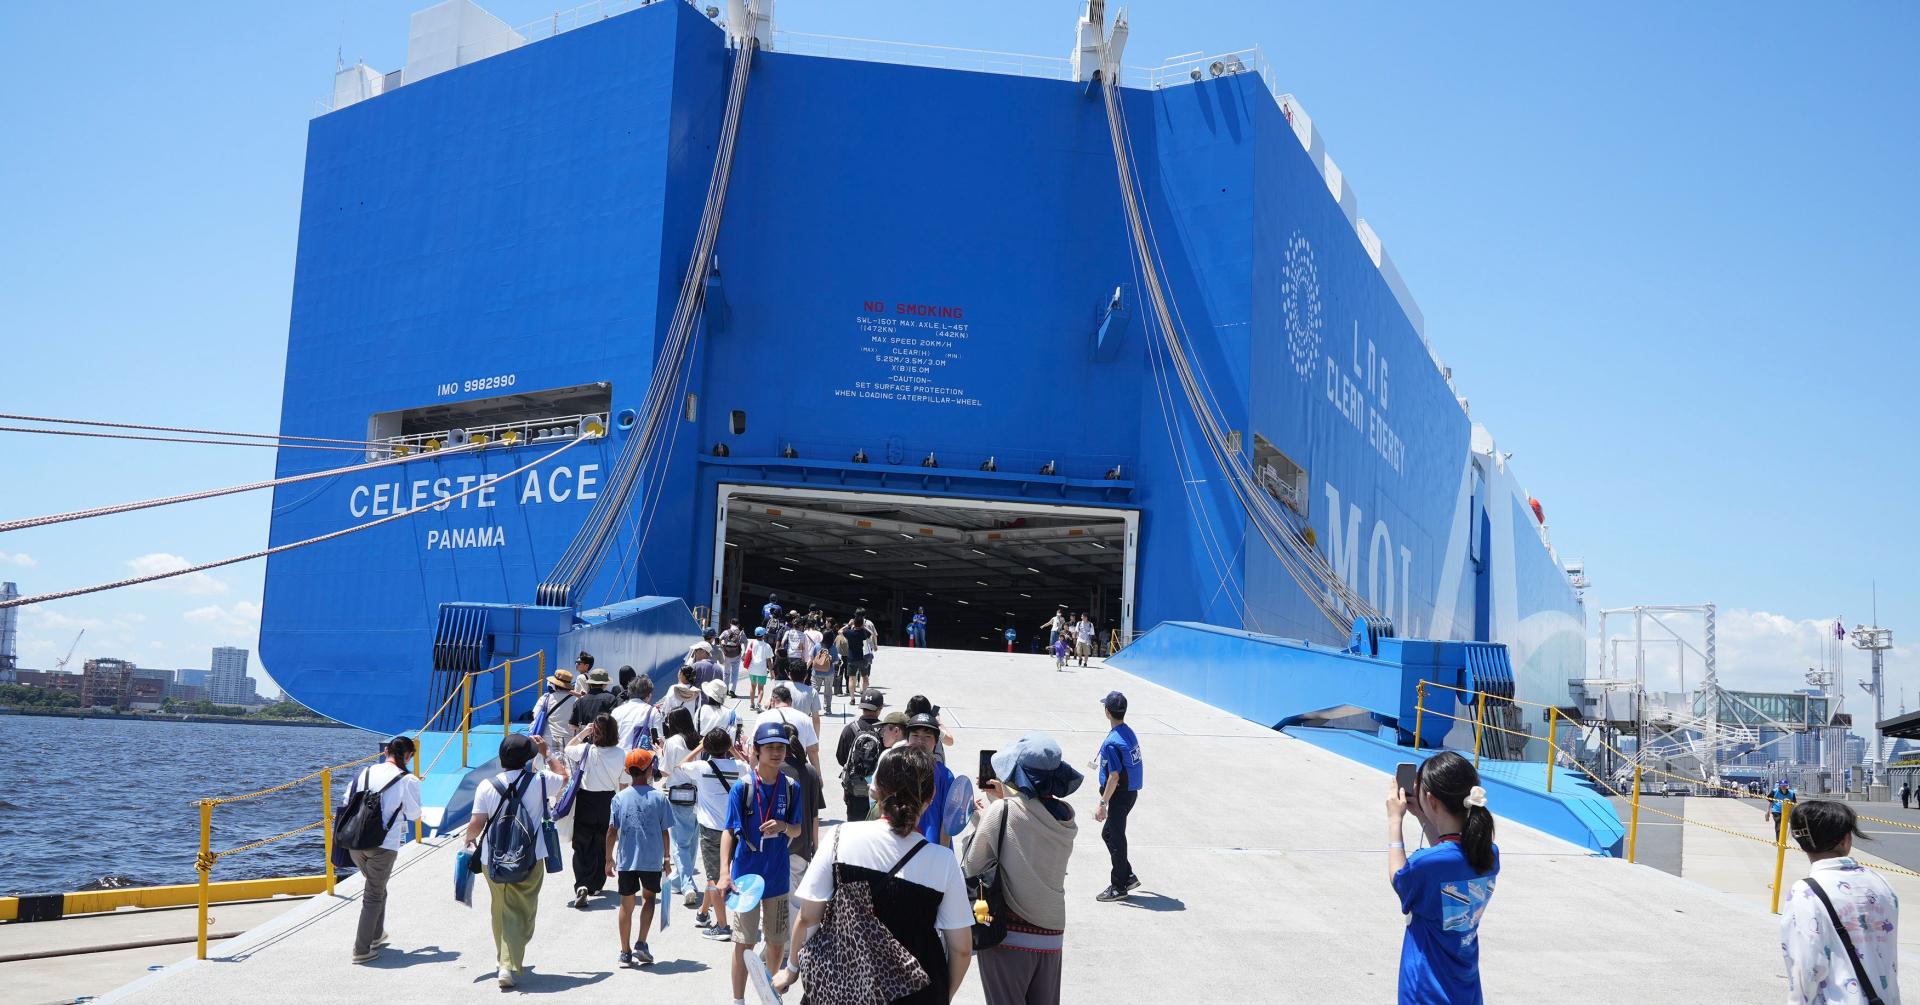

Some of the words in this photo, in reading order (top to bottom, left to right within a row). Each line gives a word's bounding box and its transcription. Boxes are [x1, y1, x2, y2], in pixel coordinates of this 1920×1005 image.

[864, 301, 884, 313] NO
[897, 303, 963, 319] SMOKING
[856, 317, 897, 326] SWL-150T
[936, 331, 969, 339] (442KN)
[920, 340, 952, 348] 20KM/H
[437, 382, 458, 396] IMO
[464, 374, 517, 393] 9982990
[914, 386, 963, 395] PROTECTION
[897, 394, 982, 406] CATERPILLAR-WHEEL
[349, 473, 498, 518] CELESTE
[520, 463, 599, 505] ACE
[427, 526, 506, 550] PANAMA
[1325, 480, 1421, 638] MOL
